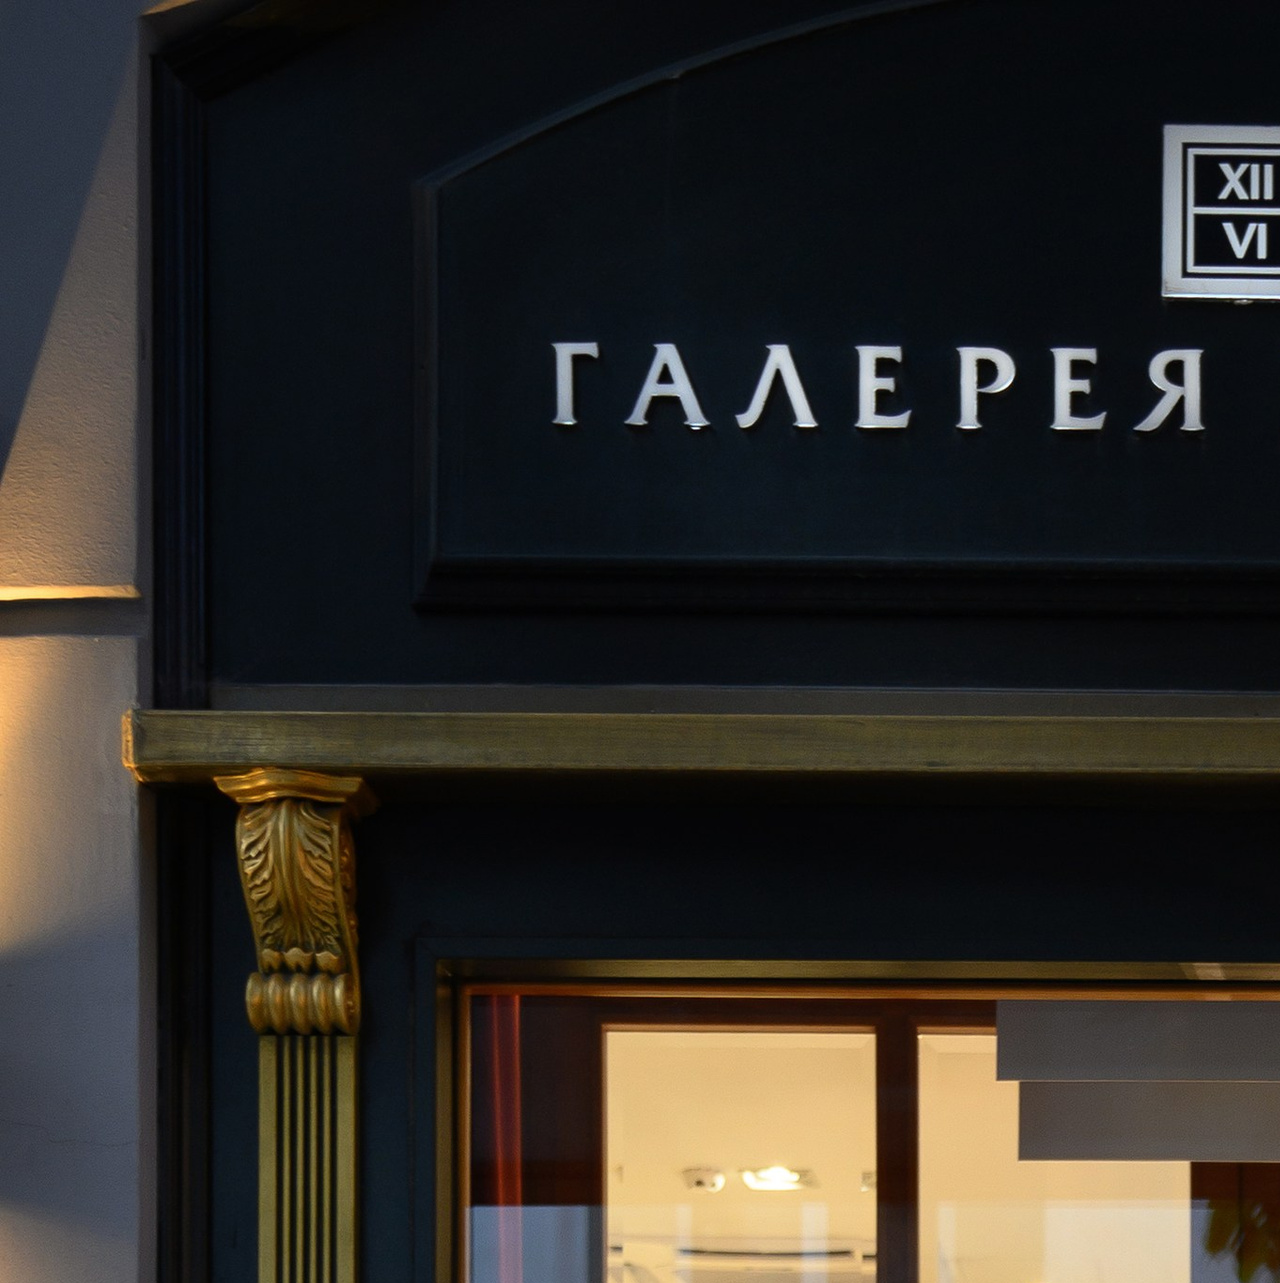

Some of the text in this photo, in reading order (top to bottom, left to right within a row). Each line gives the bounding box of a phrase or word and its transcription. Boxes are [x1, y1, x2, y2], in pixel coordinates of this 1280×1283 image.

[1218, 163, 1273, 200] XII
[1222, 222, 1267, 259] VI
[551, 342, 1206, 432] ГАЛЕРЕЯ
